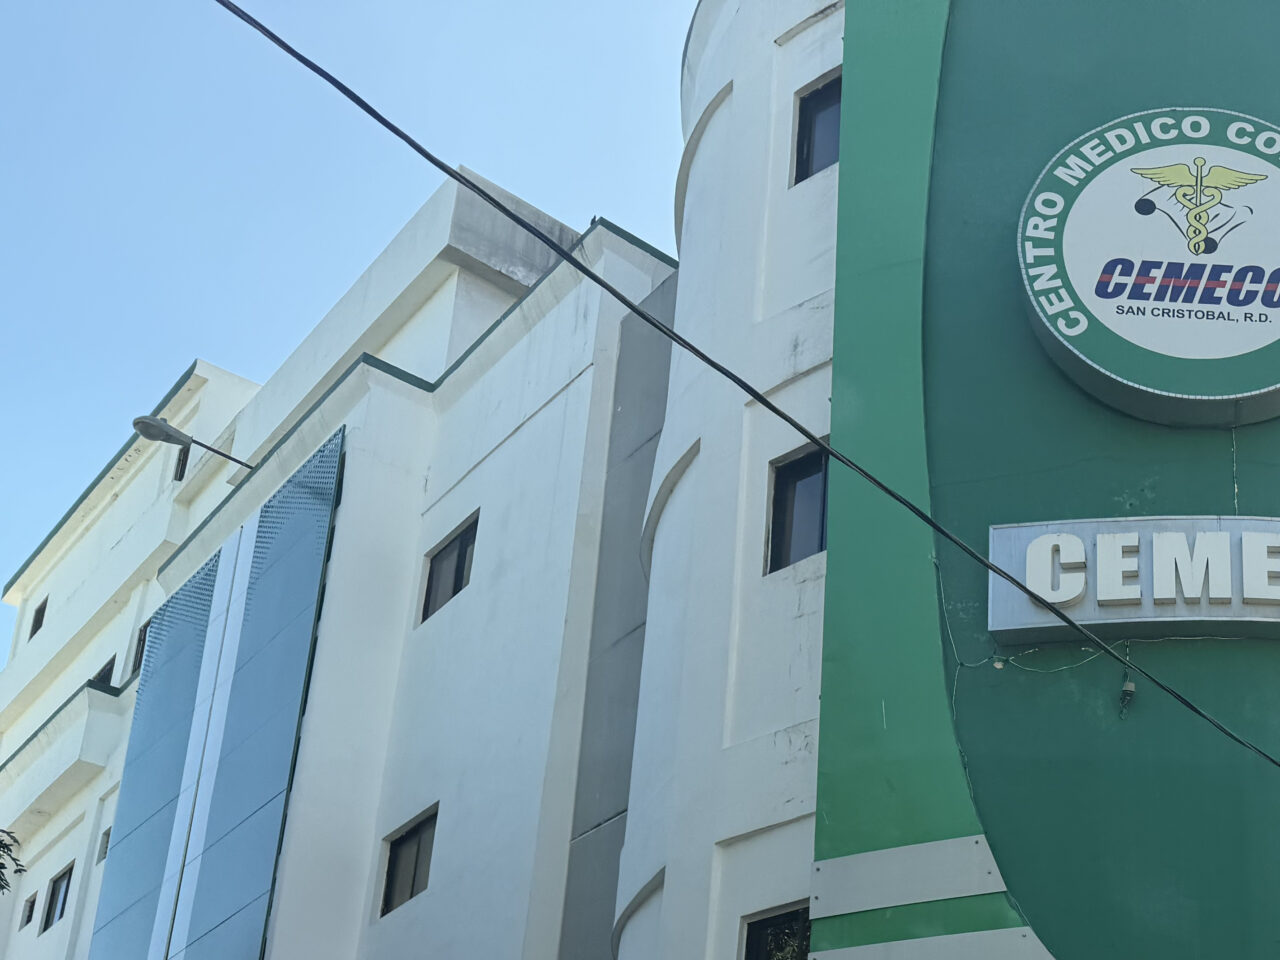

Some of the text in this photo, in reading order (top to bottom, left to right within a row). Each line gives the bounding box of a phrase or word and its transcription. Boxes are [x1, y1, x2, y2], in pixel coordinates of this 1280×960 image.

[1053, 115, 1210, 187] MEDICO
[1025, 191, 1089, 337] CENTRO
[1115, 305, 1272, 324] SAN CRISTOBAL, R.D.
